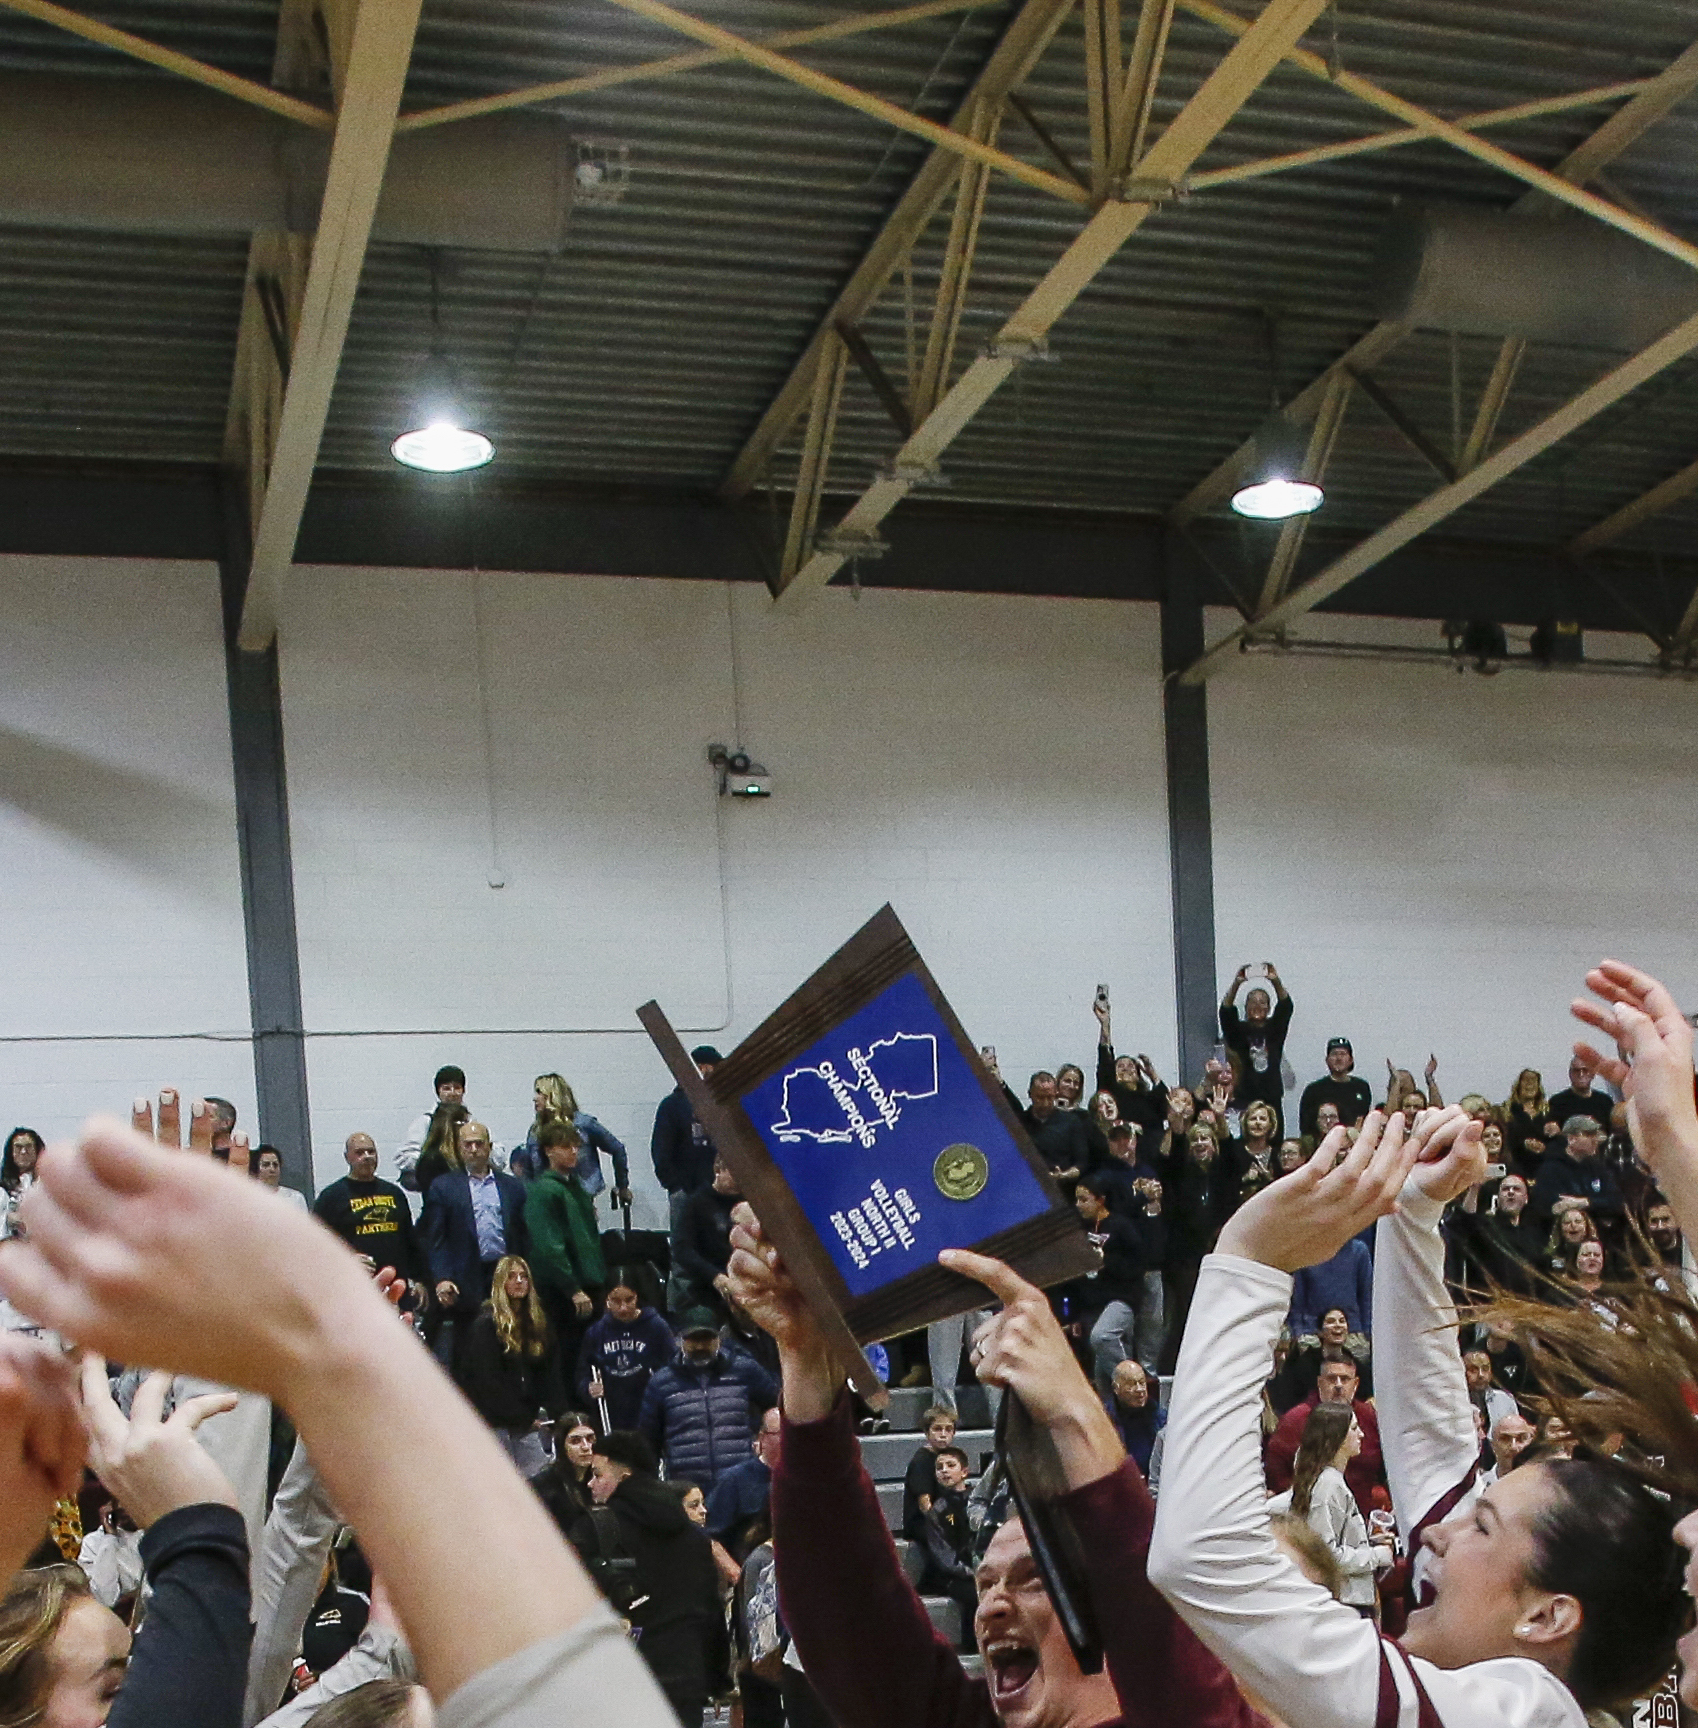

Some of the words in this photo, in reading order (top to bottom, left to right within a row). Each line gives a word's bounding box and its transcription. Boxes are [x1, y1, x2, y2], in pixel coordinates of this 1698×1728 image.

[819, 1061, 876, 1149] CHAMPIONS
[847, 1047, 900, 1130] SECTIONAL
[848, 1207, 878, 1247] GROUP
[861, 1197, 891, 1240] NORTH
[870, 1178, 915, 1251] VOLLEYBALL
[894, 1187, 921, 1224] GIRLS
[830, 1211, 870, 1270] 2023-2024
